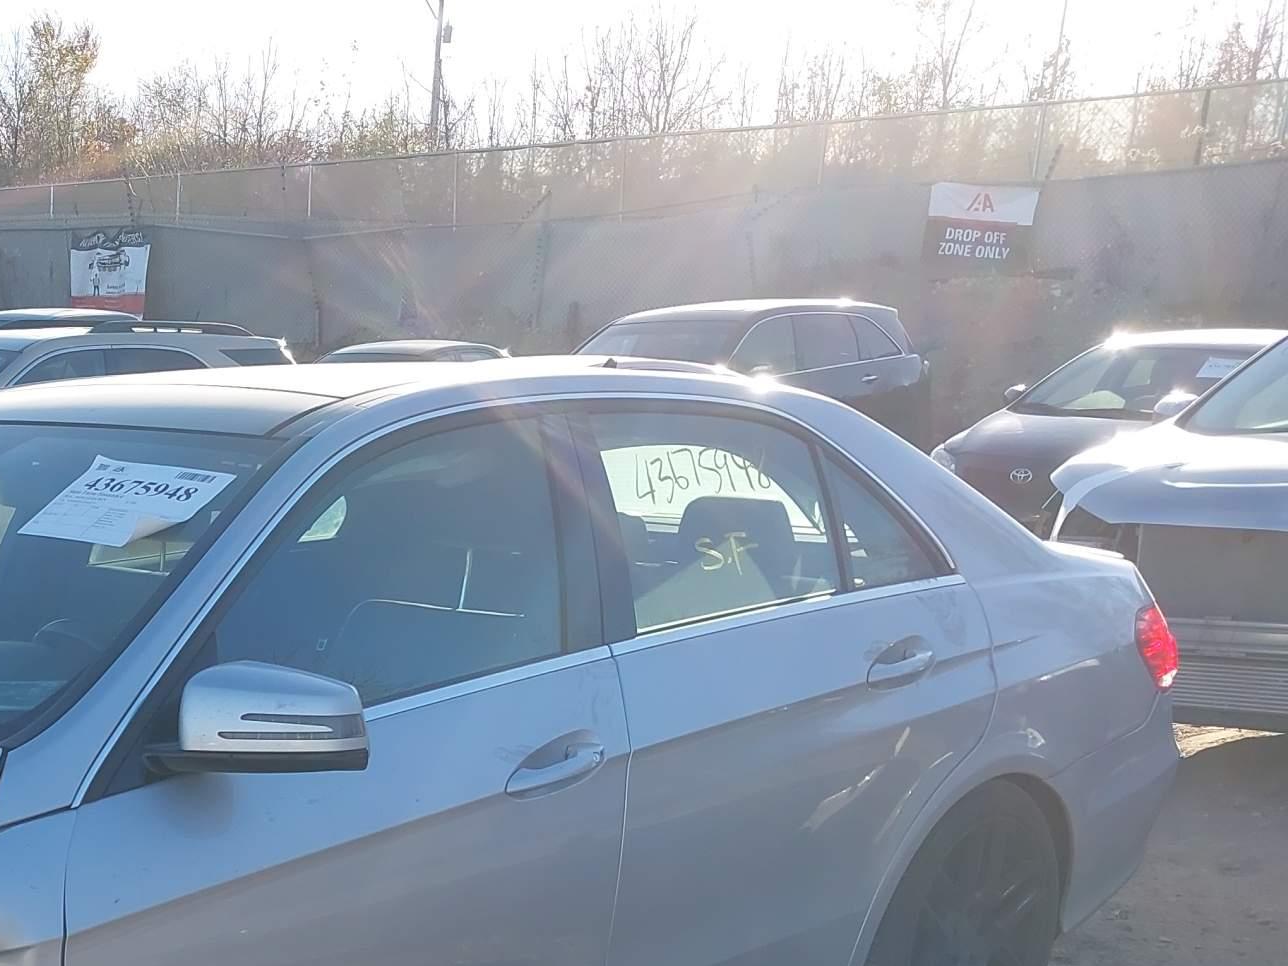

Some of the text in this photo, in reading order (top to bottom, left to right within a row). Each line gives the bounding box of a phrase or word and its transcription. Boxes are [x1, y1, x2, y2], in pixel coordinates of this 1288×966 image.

[945, 227, 1007, 244] DROP OFF
[938, 242, 1010, 259] ZONE ONLY
[84, 477, 199, 502] 43675948
